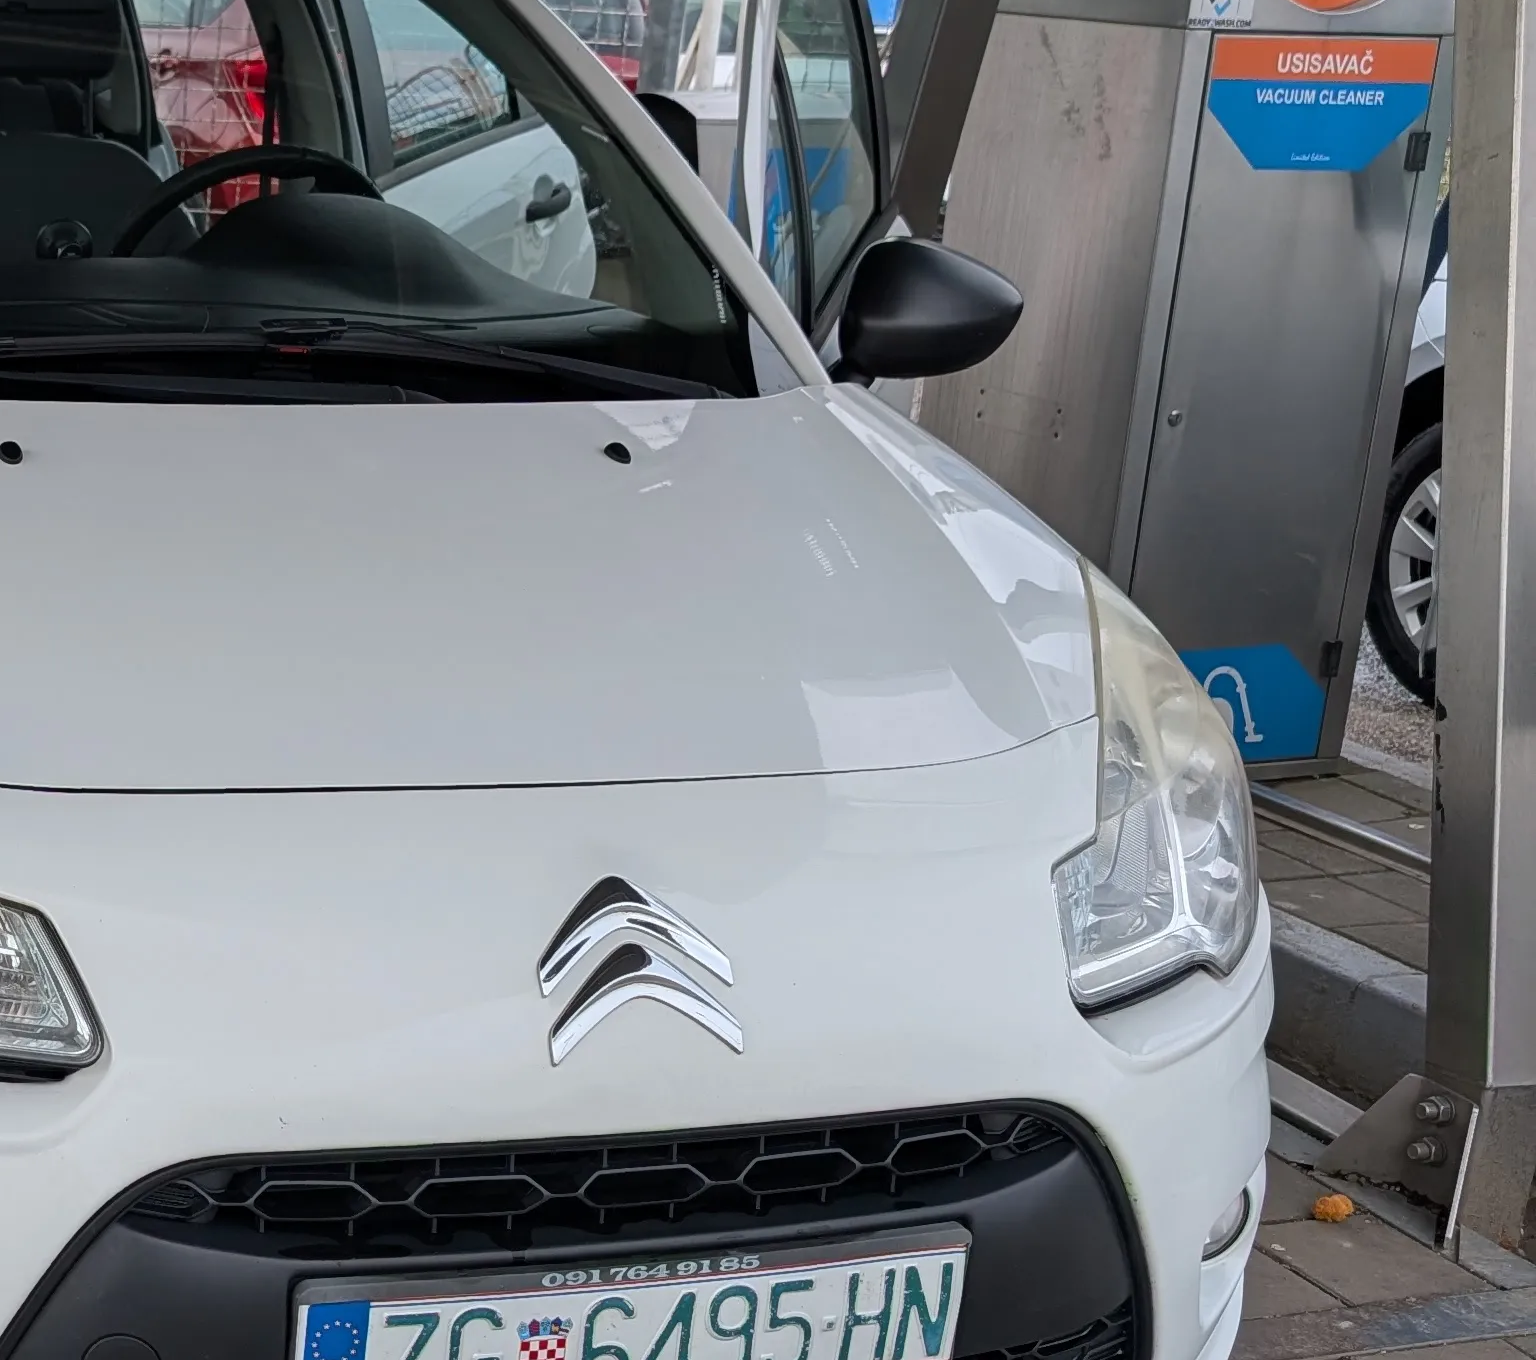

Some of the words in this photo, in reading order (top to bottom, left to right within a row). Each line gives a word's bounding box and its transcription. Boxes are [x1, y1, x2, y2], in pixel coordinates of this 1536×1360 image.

[1277, 49, 1374, 75] USISAVAČ
[1256, 88, 1315, 104] VACUUM
[1319, 90, 1385, 105] CLEANER
[541, 1269, 603, 1288] 091
[610, 1263, 670, 1282] 764
[676, 1259, 713, 1276] 91
[719, 1255, 761, 1272] 85
